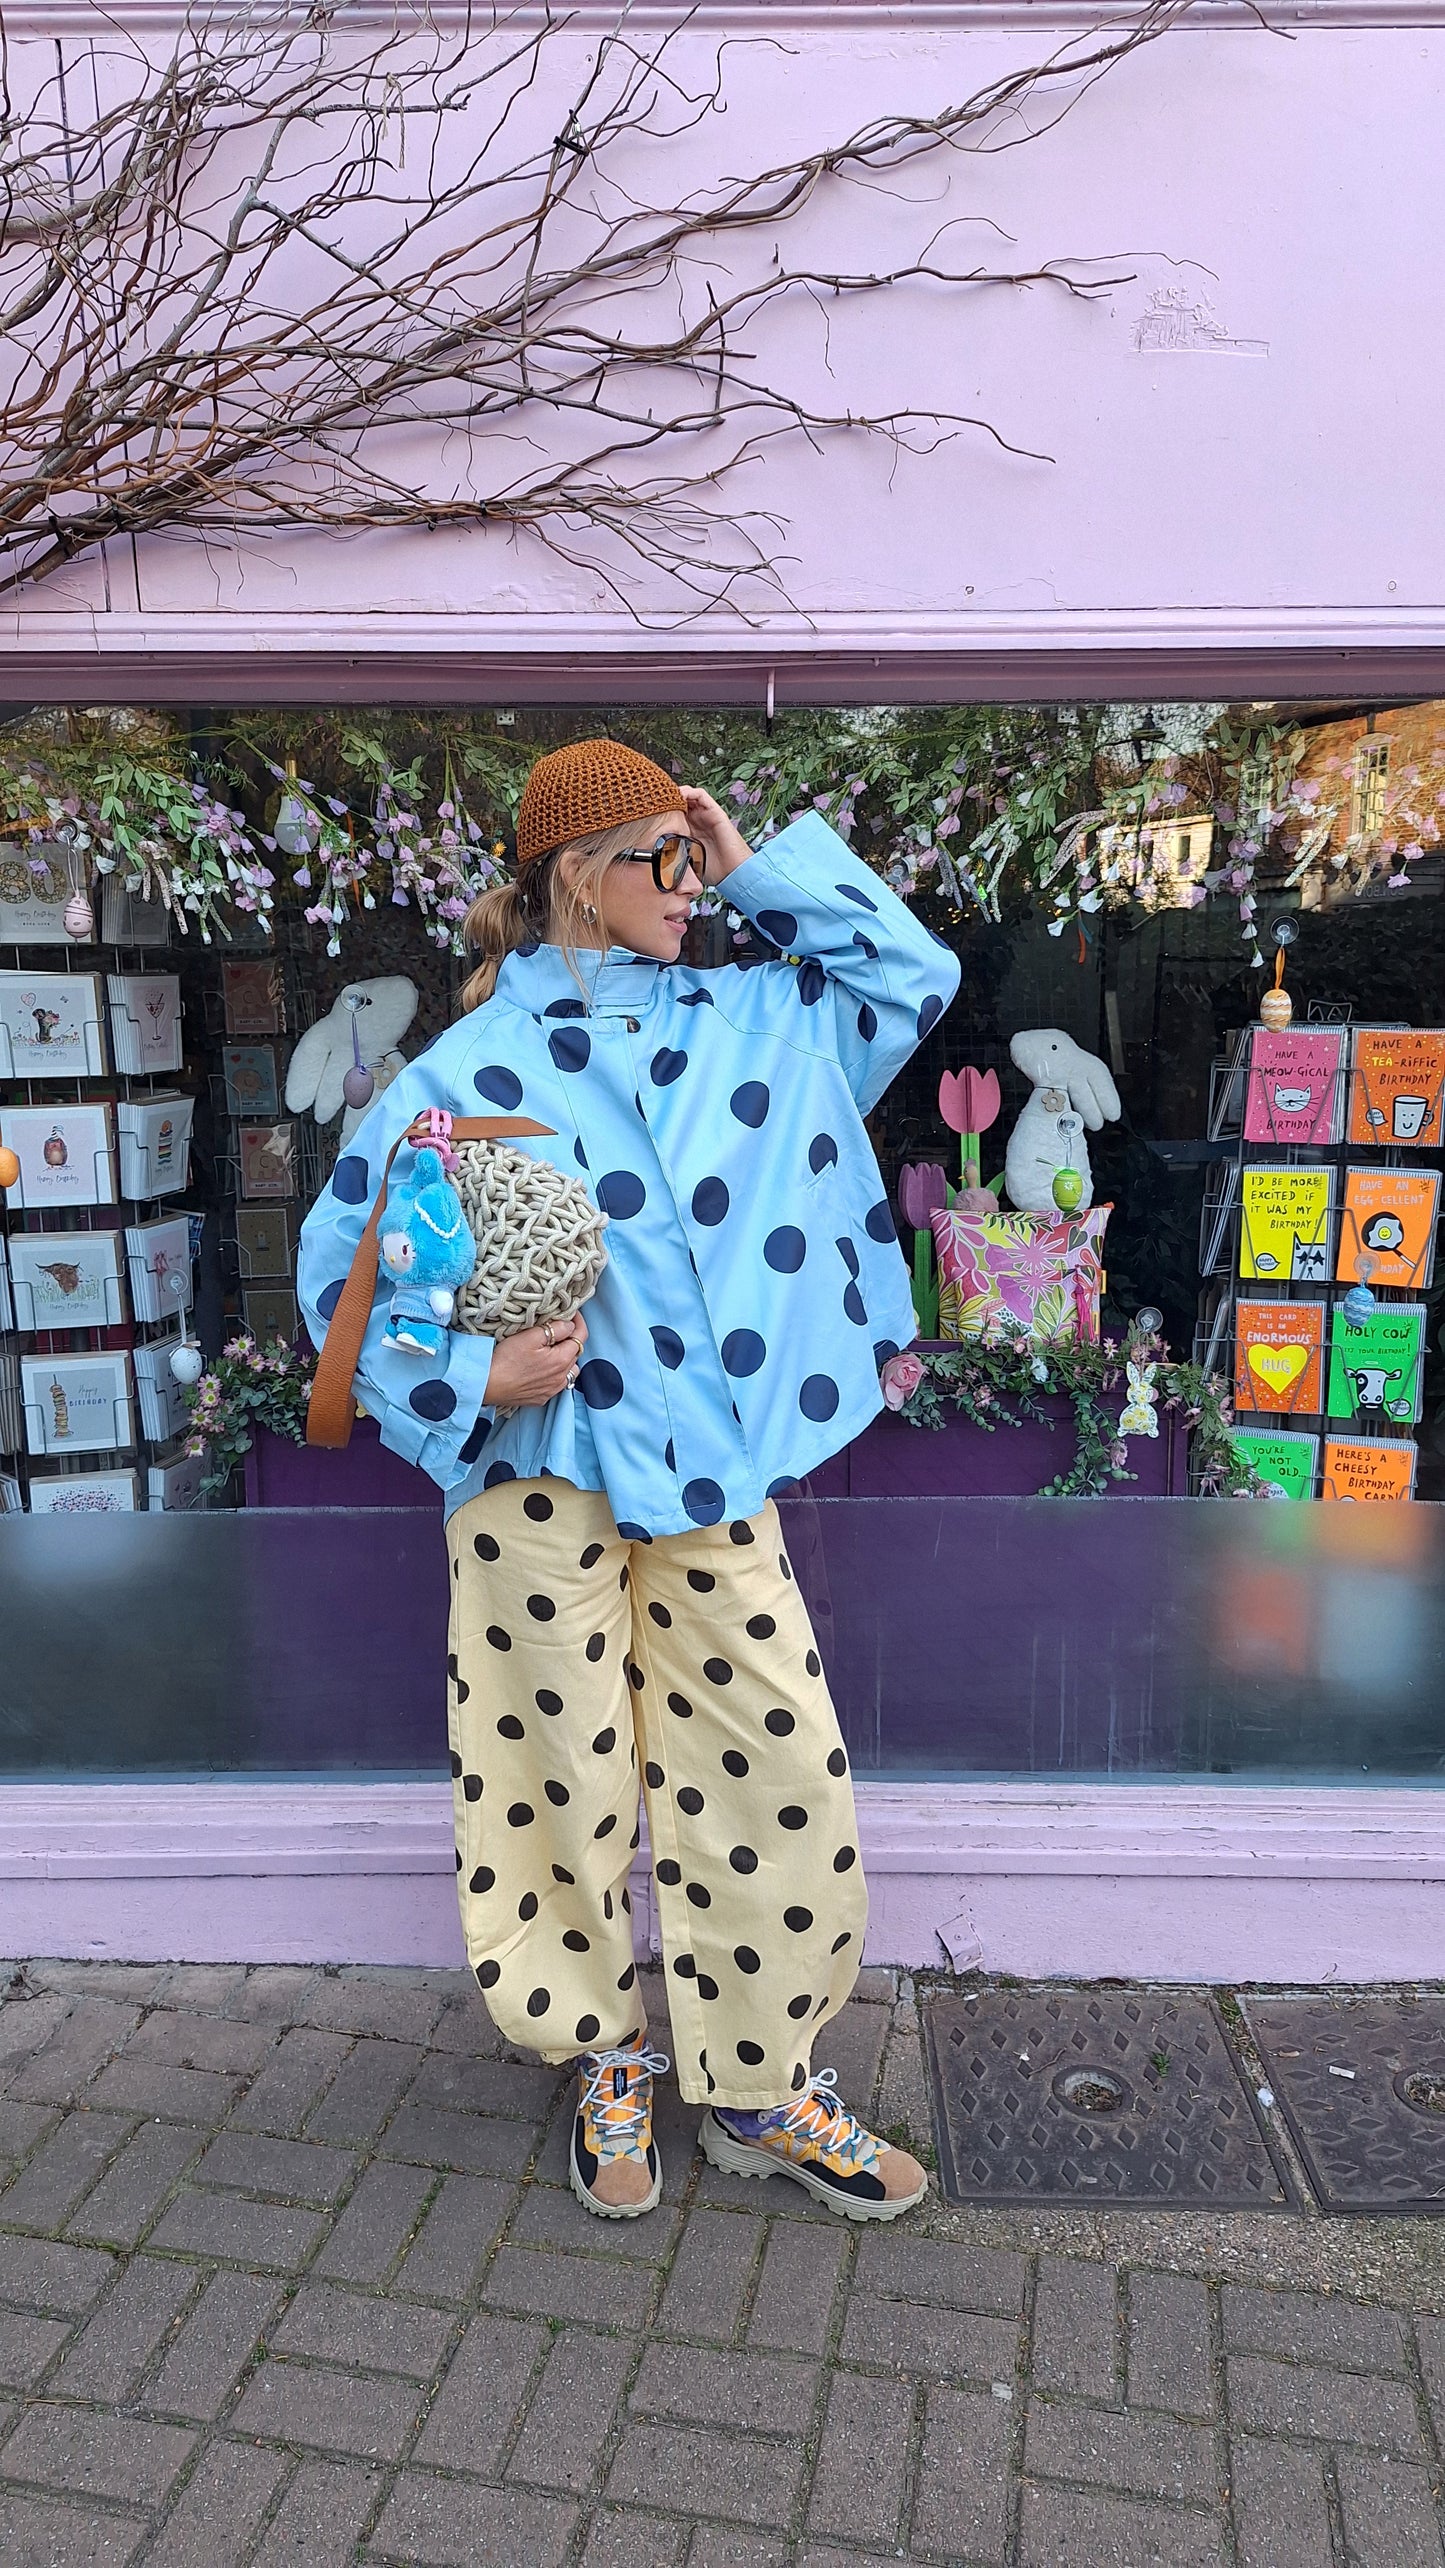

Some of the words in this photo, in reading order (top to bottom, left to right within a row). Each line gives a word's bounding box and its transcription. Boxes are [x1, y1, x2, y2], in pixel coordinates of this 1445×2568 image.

[1373, 1038, 1402, 1049] HAVE
[1415, 1039, 1422, 1048] A
[1275, 1051, 1298, 1059] HAVE
[1308, 1051, 1314, 1059] A
[1379, 1073, 1432, 1085] BIRTHDAY
[1251, 1176, 1264, 1186] I'D
[1271, 1178, 1283, 1186] BE
[1290, 1178, 1320, 1187] MORE
[1360, 1180, 1383, 1190] HAVE
[1396, 1181, 1409, 1190] AN
[1266, 1205, 1288, 1214] WAS
[1296, 1206, 1312, 1214] MY
[1258, 1312, 1273, 1320] THIS
[1247, 1331, 1313, 1344] ENORMOUS
[1345, 1326, 1377, 1338] HOLY
[1382, 1327, 1411, 1338] COW
[1262, 1358, 1291, 1373] HUG
[1252, 1445, 1285, 1455] YOU'RE
[1336, 1448, 1371, 1461] HERE'S
[1380, 1454, 1387, 1463] A
[1269, 1457, 1292, 1465] NOT
[1334, 1462, 1378, 1475] CHEESY
[1348, 1476, 1396, 1491] BIRTHDAY
